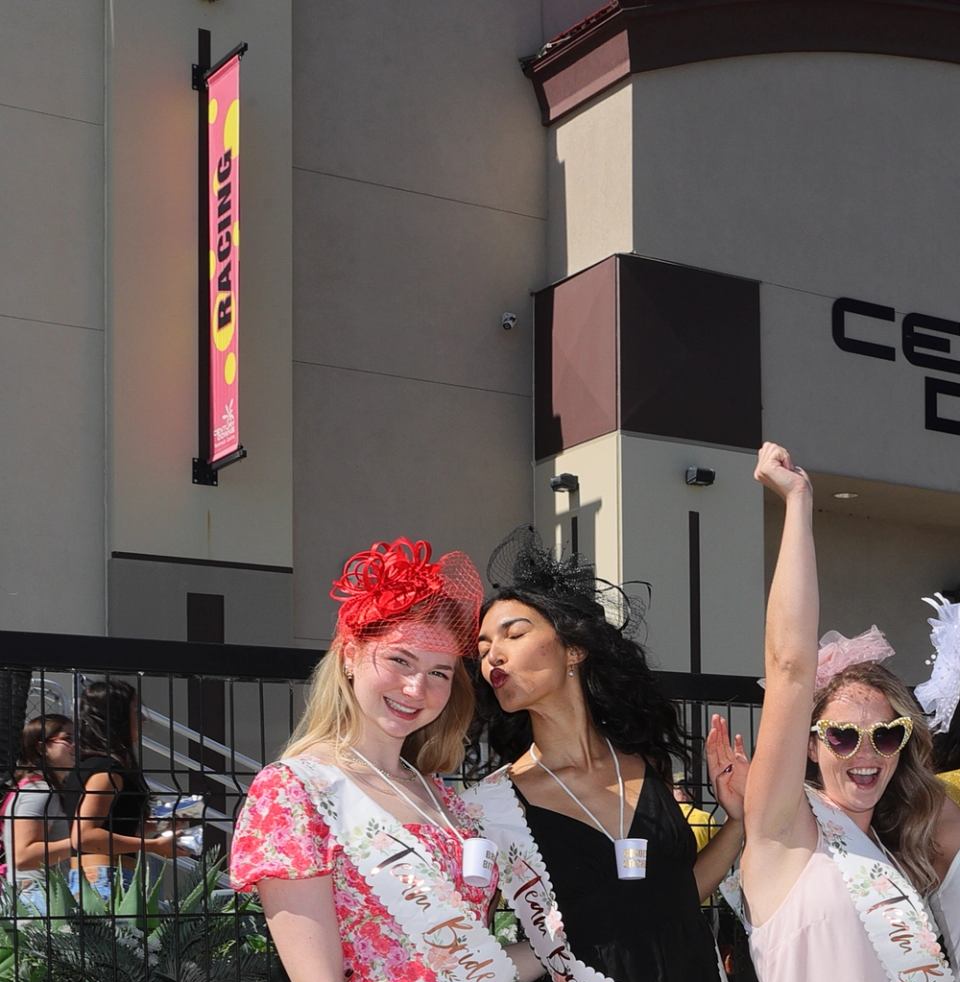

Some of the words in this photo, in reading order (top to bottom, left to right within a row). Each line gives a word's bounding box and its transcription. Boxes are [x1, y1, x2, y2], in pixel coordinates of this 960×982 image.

[217, 149, 232, 331] RACING
[370, 832, 434, 912] Team
[513, 859, 550, 936] Team
